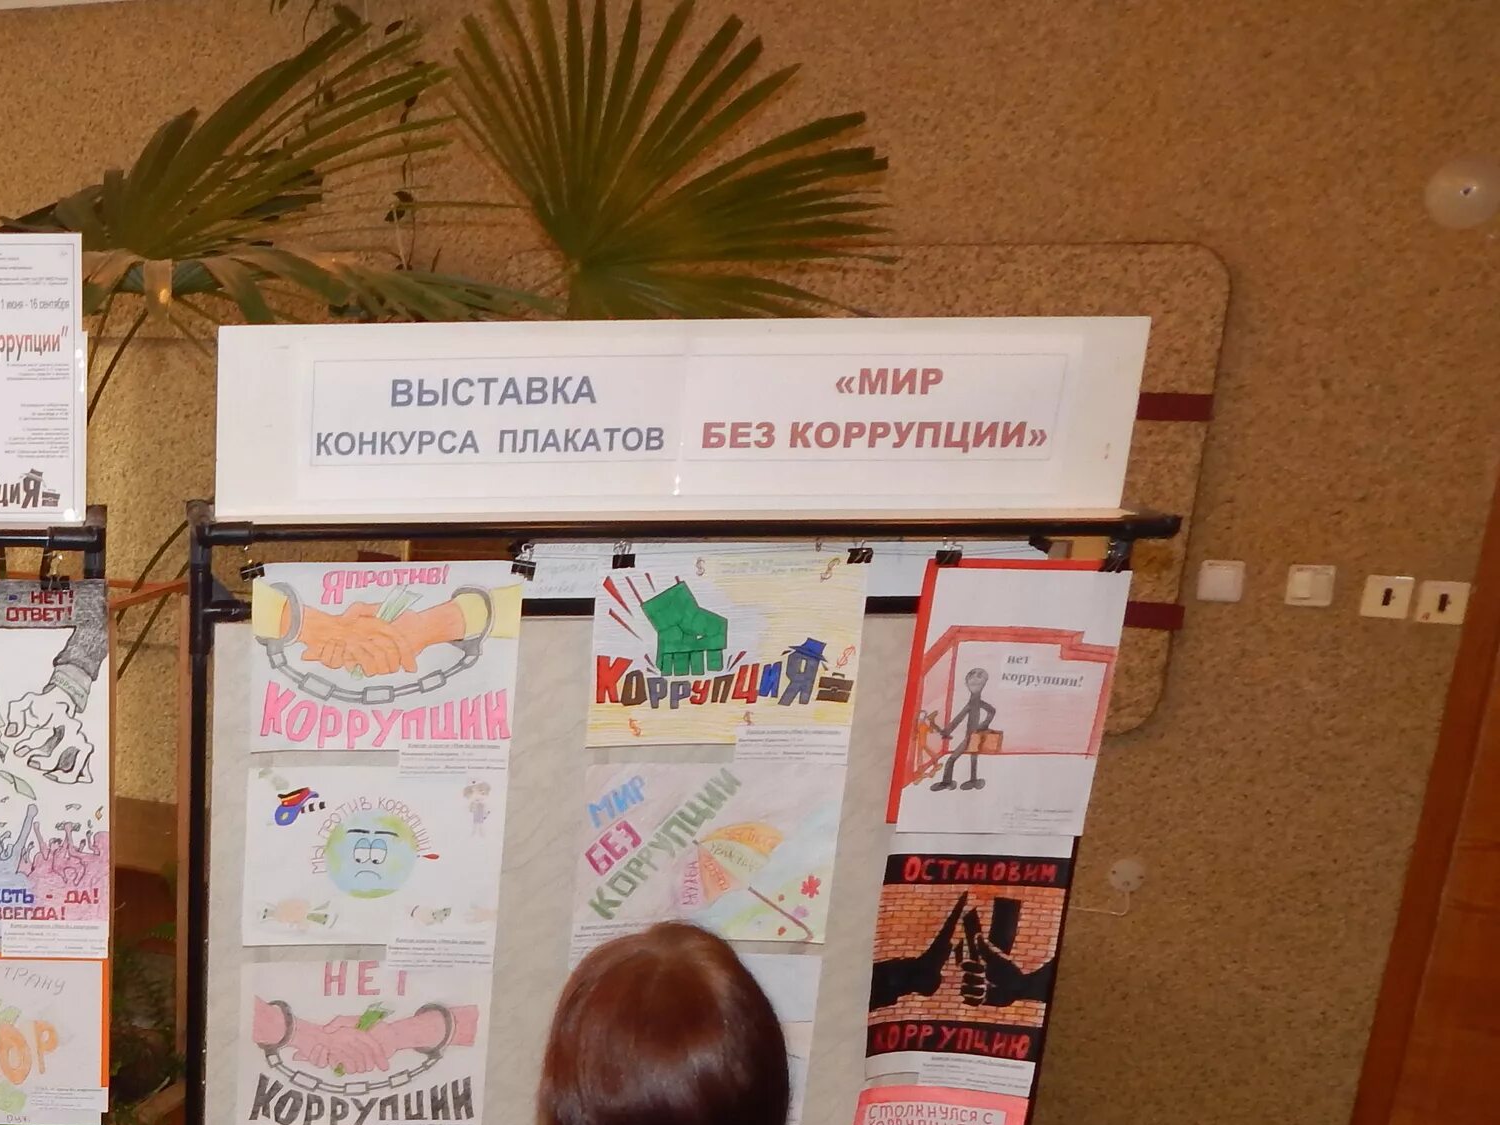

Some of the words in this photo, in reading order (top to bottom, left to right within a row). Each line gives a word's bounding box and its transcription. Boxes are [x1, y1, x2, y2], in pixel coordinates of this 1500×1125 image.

[7, 301, 23, 309] июня
[30, 299, 37, 309] 16
[39, 299, 70, 310] сентября
[391, 375, 597, 407] ВЫСТАВКА
[835, 367, 944, 395] «МИР
[316, 429, 480, 457] КОНКУРСА
[499, 427, 665, 453] ПЛАКАТОВ
[701, 421, 776, 449] БЕЗ
[788, 421, 1048, 453] КОРРУПЦИИ»
[31, 589, 75, 605] НЕТ!
[5, 606, 73, 622] ОТВЕТ!
[1006, 655, 1031, 665] нет
[595, 650, 822, 709] КОРРУПЦИЯ
[1001, 673, 1084, 688] коррупции!
[260, 680, 512, 749] КОРРУПЦИИ
[586, 775, 646, 829] МИР
[317, 796, 373, 840] ПРОТИВ
[585, 819, 643, 876] БЕЗ
[588, 768, 742, 920] КОРРУПЦИИ
[903, 856, 1058, 882] ОСТАНОВИМ
[64, 888, 100, 904] ДА!
[875, 1024, 1031, 1059] КОРРУПЦИЮ
[869, 1105, 978, 1122] СТОЛКНУЛСЯ
